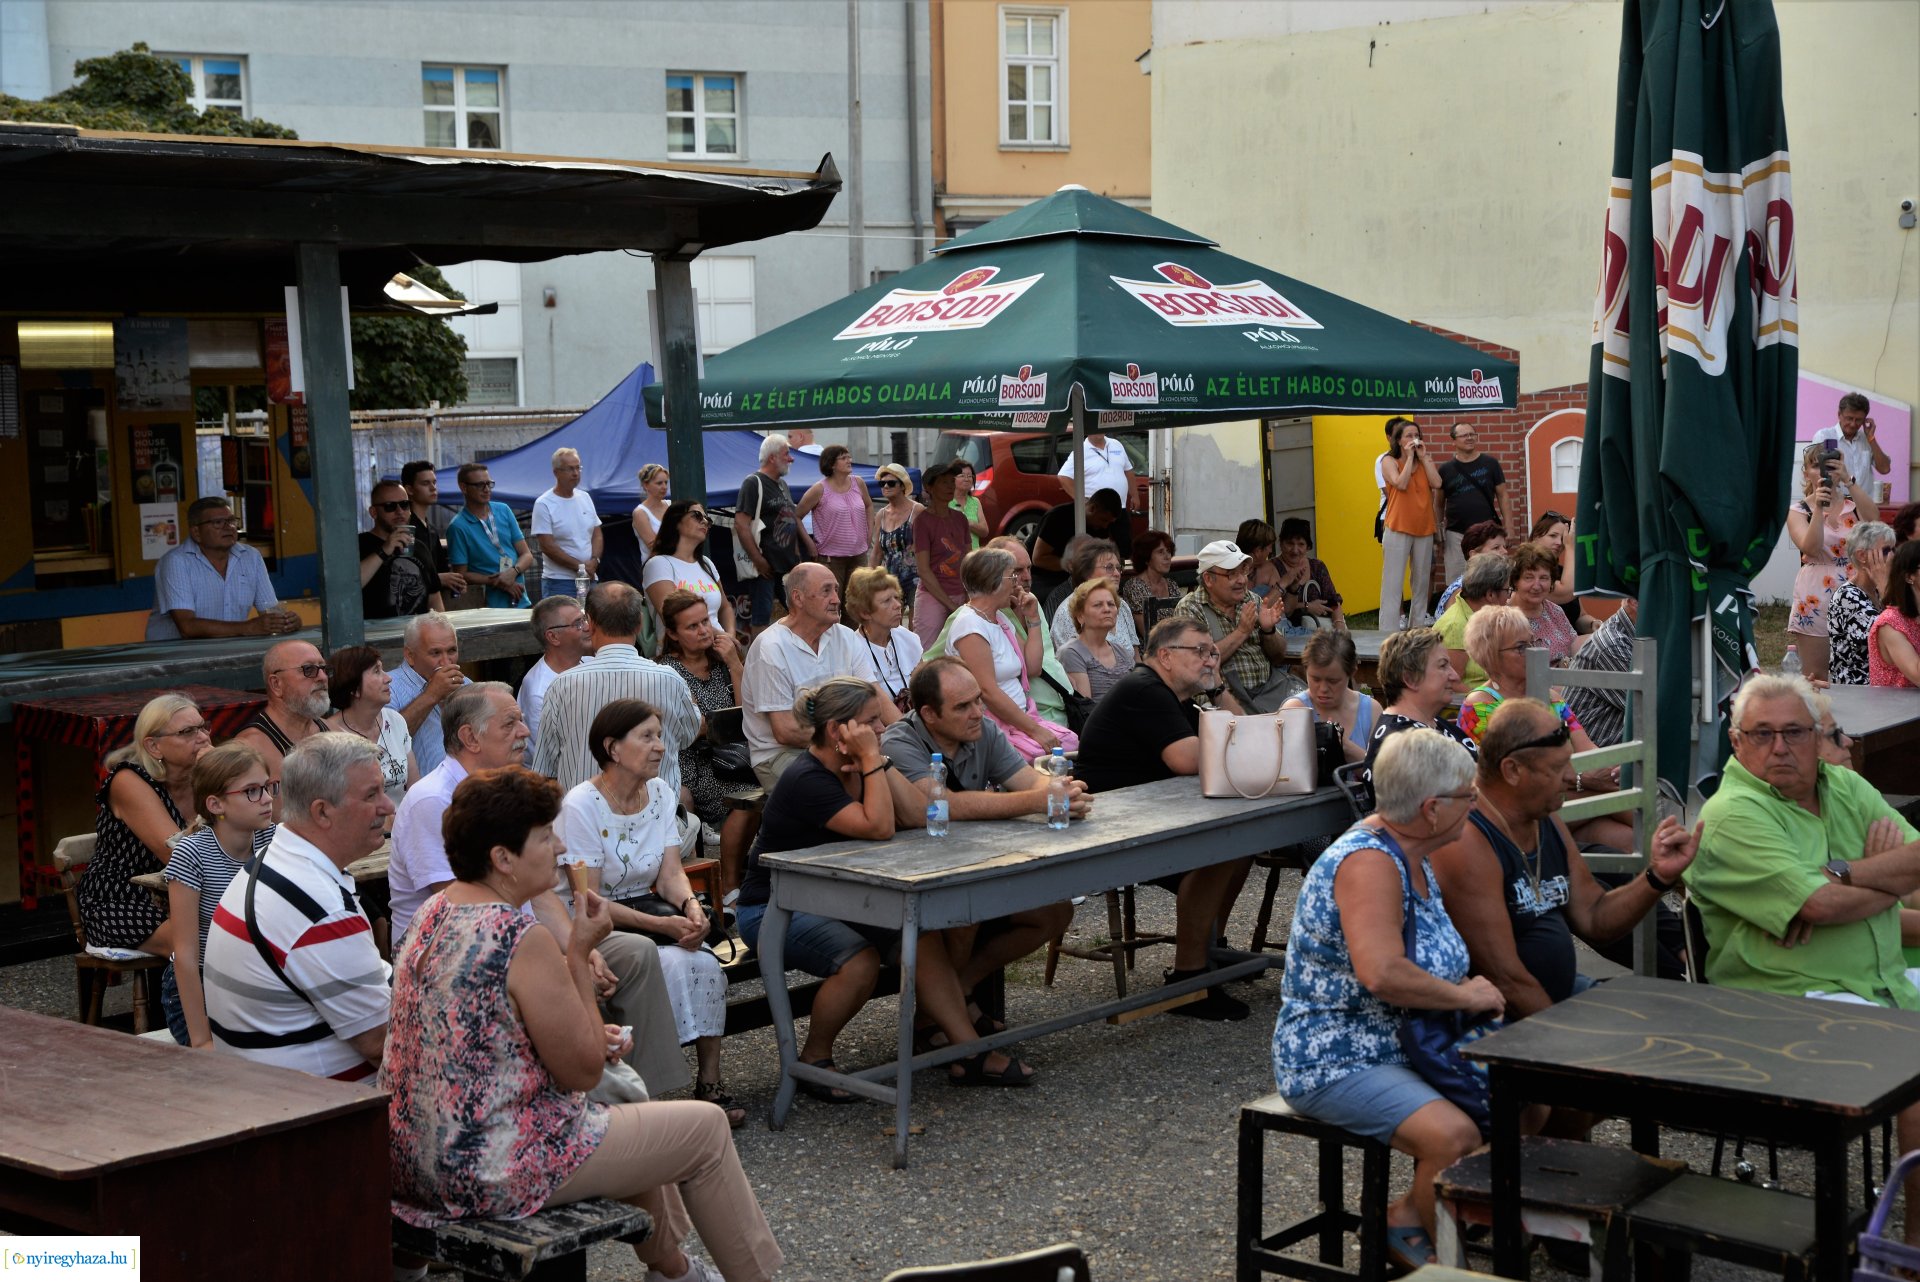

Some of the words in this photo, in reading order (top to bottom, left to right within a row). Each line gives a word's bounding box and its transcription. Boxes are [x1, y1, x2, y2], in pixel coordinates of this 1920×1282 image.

[854, 292, 1015, 328] BORSODI
[1138, 291, 1302, 319] BORSODI
[855, 336, 918, 354] PÓLÓ
[962, 375, 997, 394] PÓLÓ
[1001, 382, 1044, 400] BORSODI
[1112, 382, 1156, 398] BORSODI
[1161, 373, 1194, 392] PÓLÓ
[1206, 377, 1230, 396] AZ
[1237, 372, 1280, 396] ÉLET
[1287, 375, 1345, 396] HABOS
[1352, 378, 1418, 398] OLDALA
[1425, 377, 1454, 394] PÓLÓ
[703, 391, 733, 409] PÓLÓ
[740, 393, 763, 411] AZ
[767, 387, 808, 410] ÉLET
[812, 384, 872, 406] HABOS
[877, 382, 951, 403] OLDALA
[1459, 385, 1500, 399] BORSODI
[133, 430, 153, 438] OUR
[134, 438, 166, 446] HOUSE
